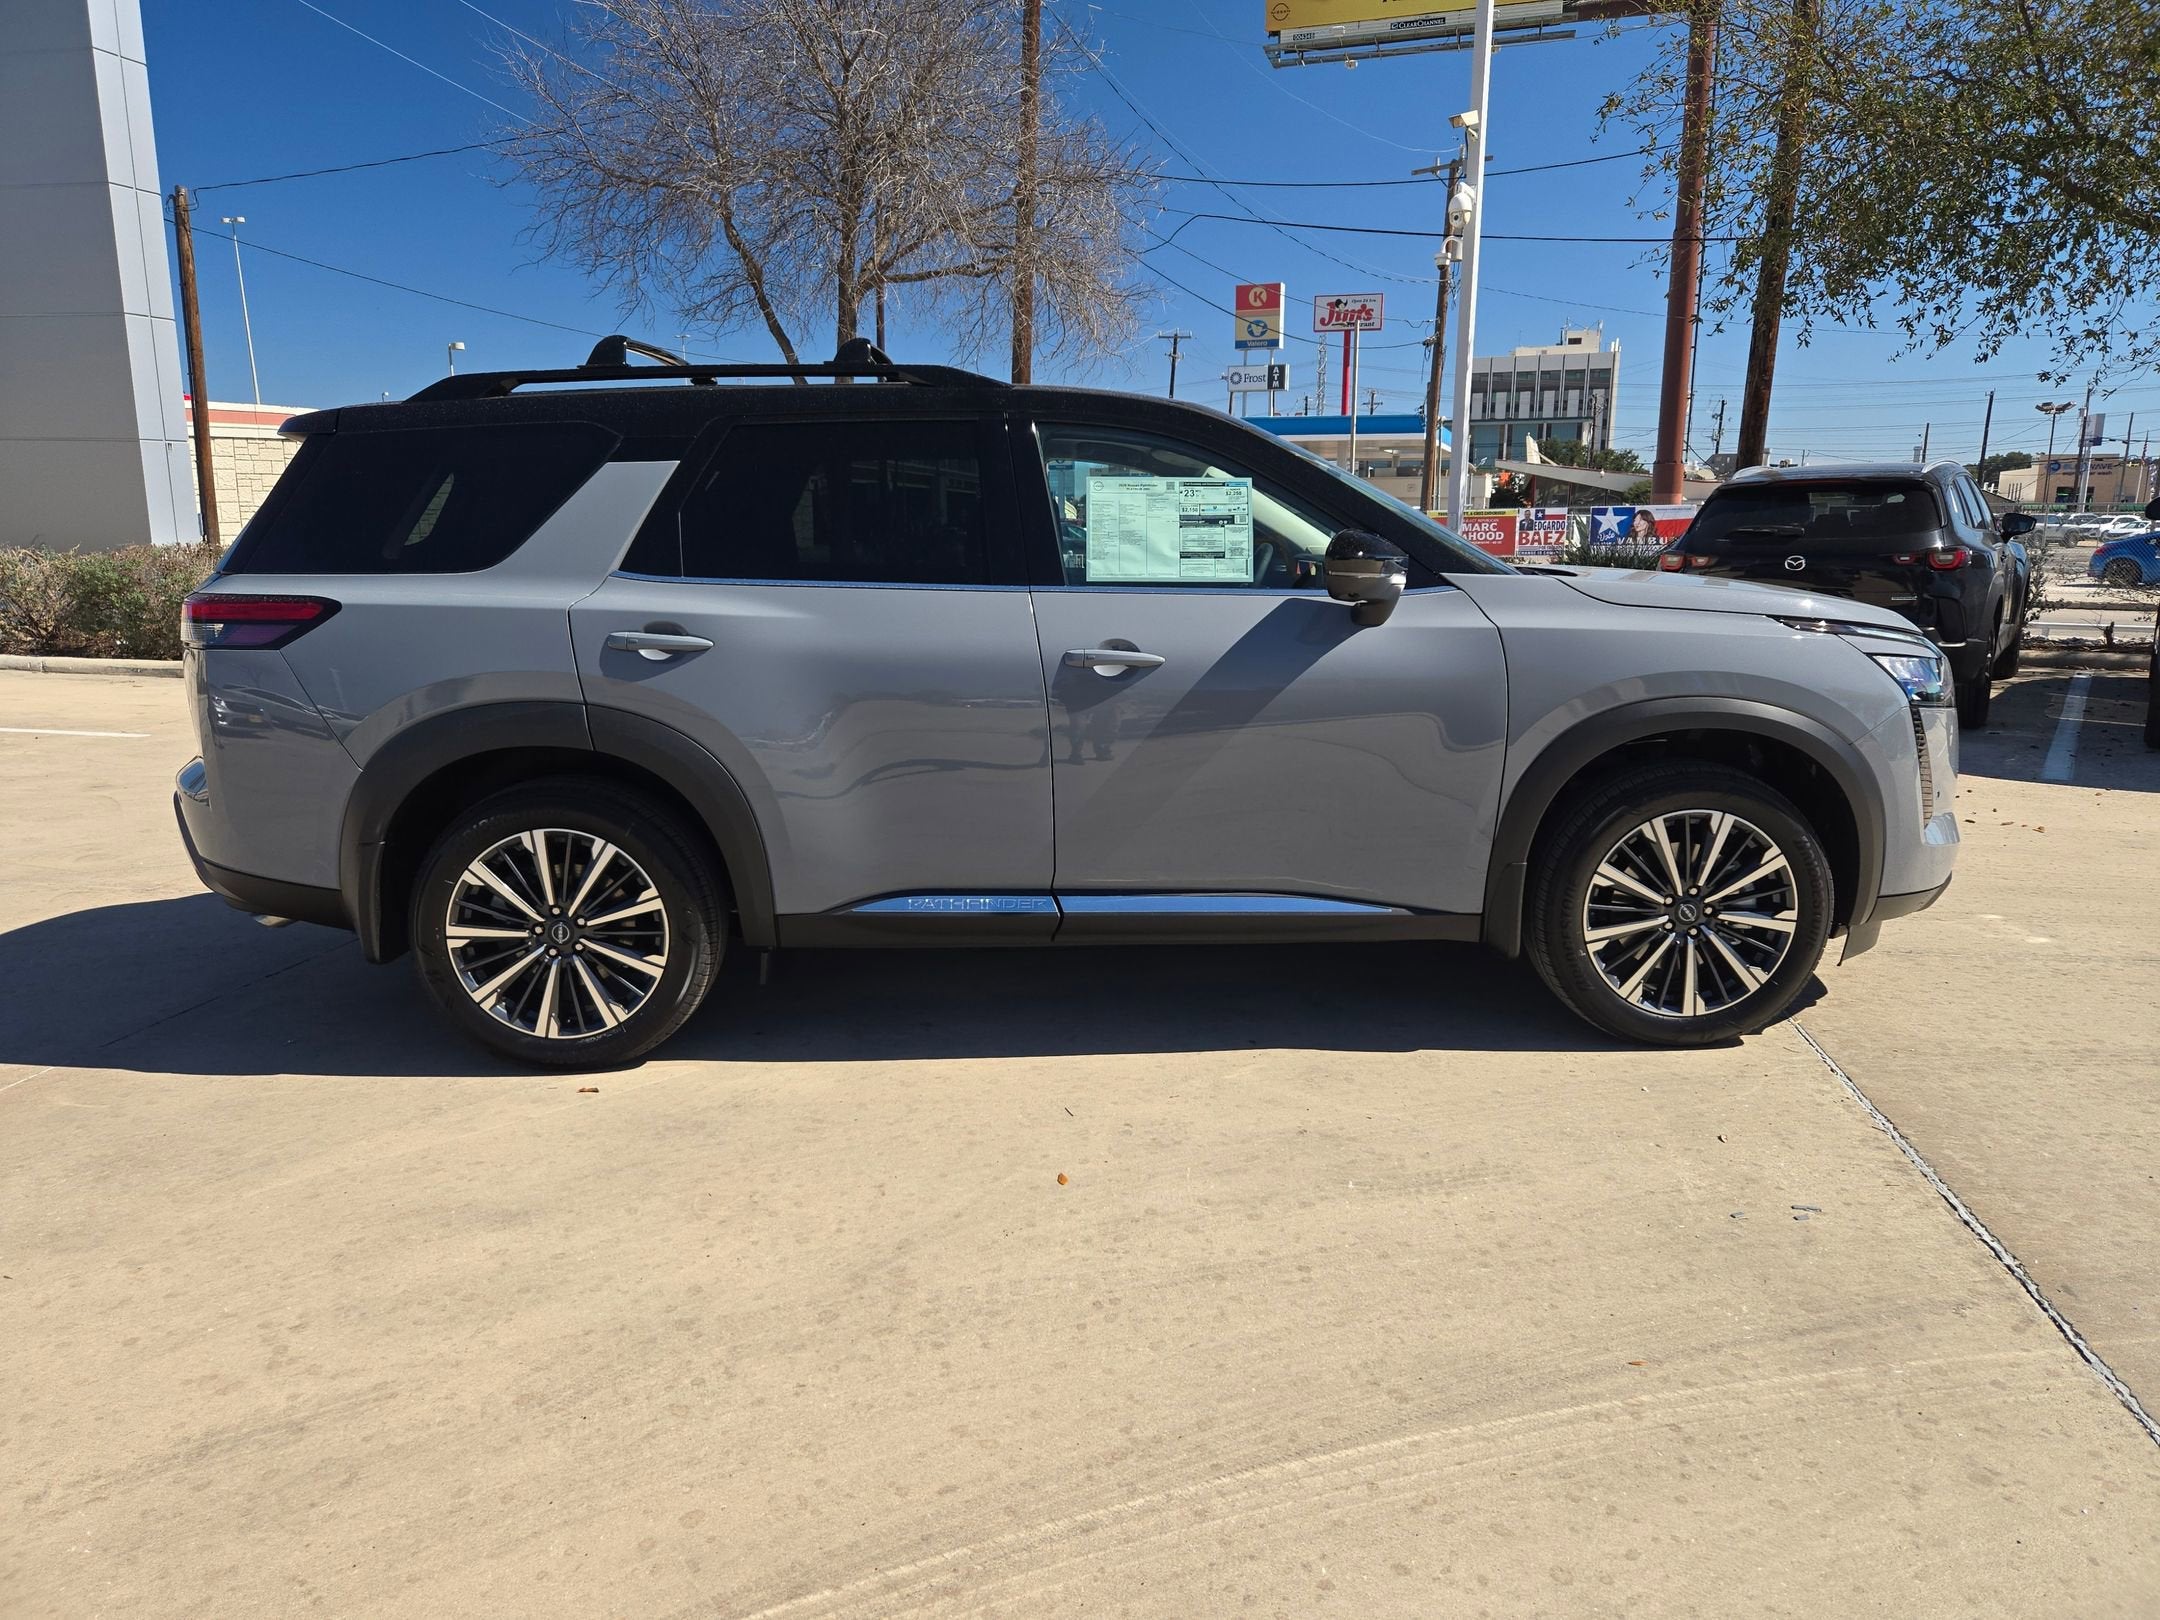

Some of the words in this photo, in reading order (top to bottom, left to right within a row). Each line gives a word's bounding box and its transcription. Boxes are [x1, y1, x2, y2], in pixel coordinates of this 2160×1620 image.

[1253, 290, 1265, 306] K
[1319, 301, 1374, 327] Jim's
[1243, 373, 1267, 383] Frost
[1272, 366, 1280, 388] ATM
[1184, 489, 1195, 497] 23
[1462, 522, 1498, 532] MARC
[1534, 520, 1566, 531] EDGARDO
[1462, 531, 1504, 541] AHOOD
[1518, 531, 1566, 546] BAEZ
[907, 898, 1048, 910] PATHFINDER
